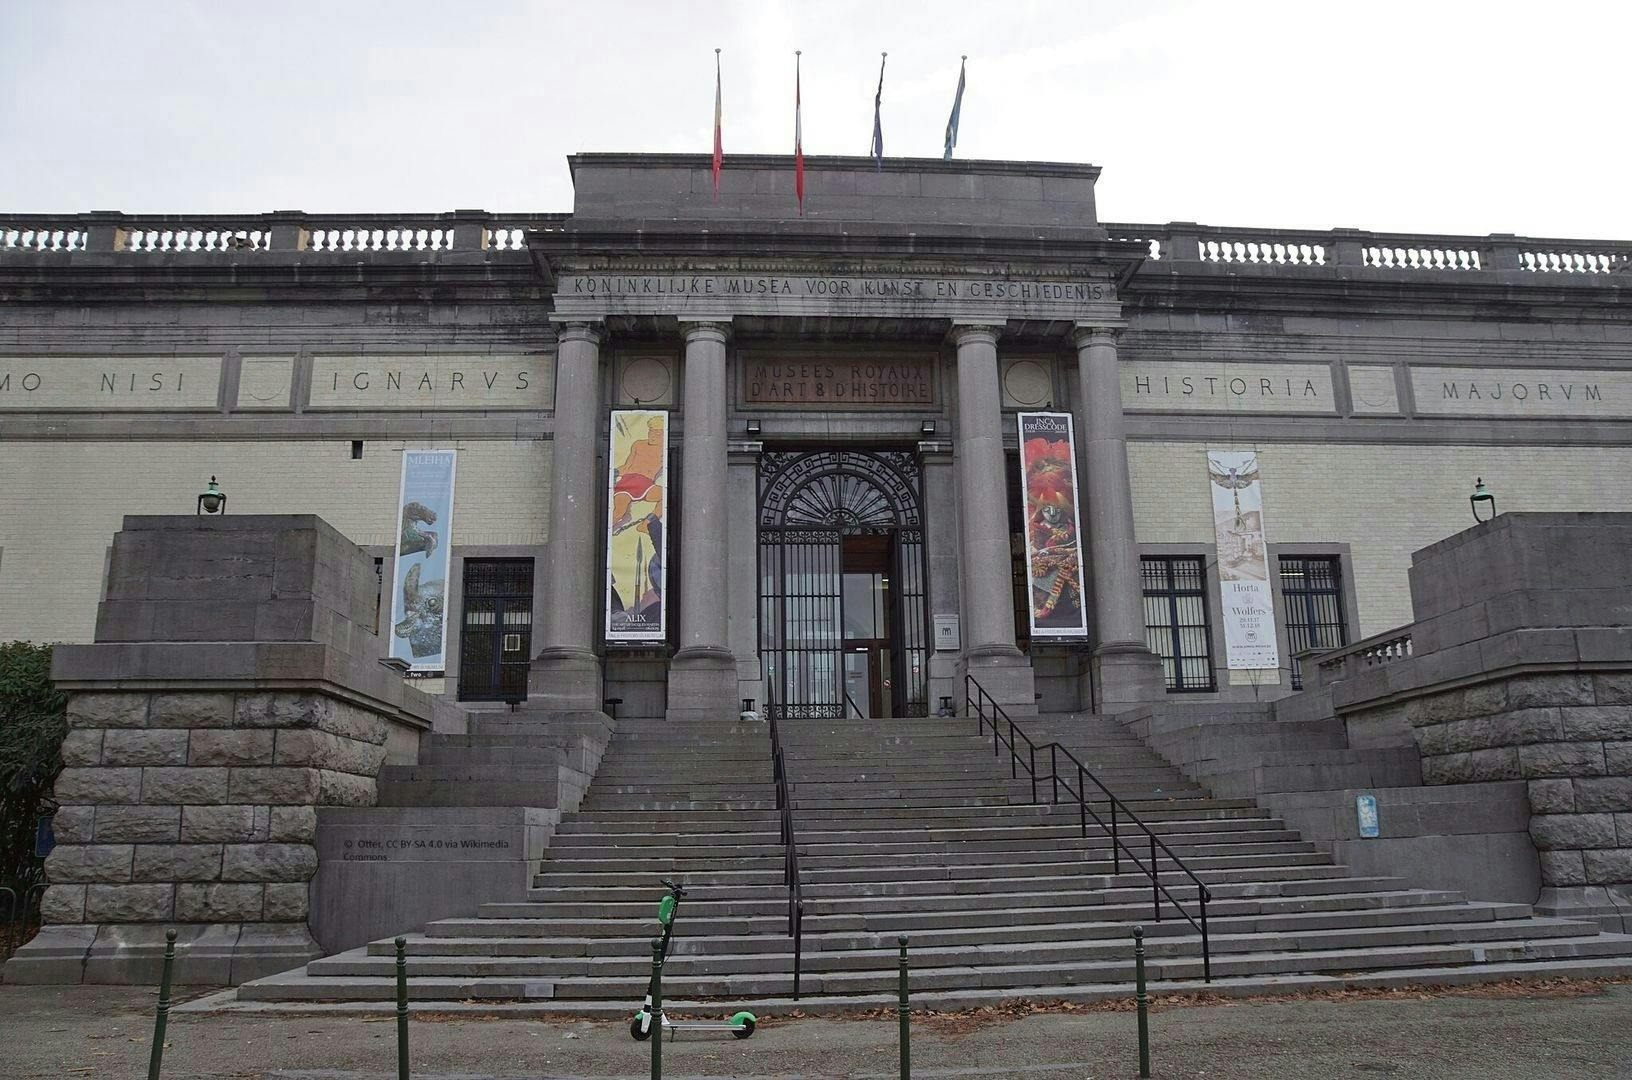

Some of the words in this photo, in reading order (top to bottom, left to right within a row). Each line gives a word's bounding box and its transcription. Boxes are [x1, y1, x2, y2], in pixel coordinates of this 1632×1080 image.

[574, 277, 714, 294] KONINKLIJKE
[726, 278, 792, 294] MUSEA
[805, 279, 852, 295] VOOR
[864, 280, 924, 297] KUNST
[936, 281, 957, 296] EN
[970, 282, 1102, 300] GESCHIEDENIS
[851, 364, 923, 380] ROYAUX
[100, 372, 184, 392] NISI
[332, 371, 530, 391] IGNARVS
[1134, 375, 1317, 397] HISTORIA
[815, 382, 826, 397] &
[1442, 381, 1603, 401] MAJORVM
[1024, 423, 1068, 431] DRESSCODE
[1036, 417, 1056, 425] INCA
[1232, 584, 1259, 592] Horta
[625, 614, 647, 622] ALIX
[1231, 606, 1267, 616] Wolfers
